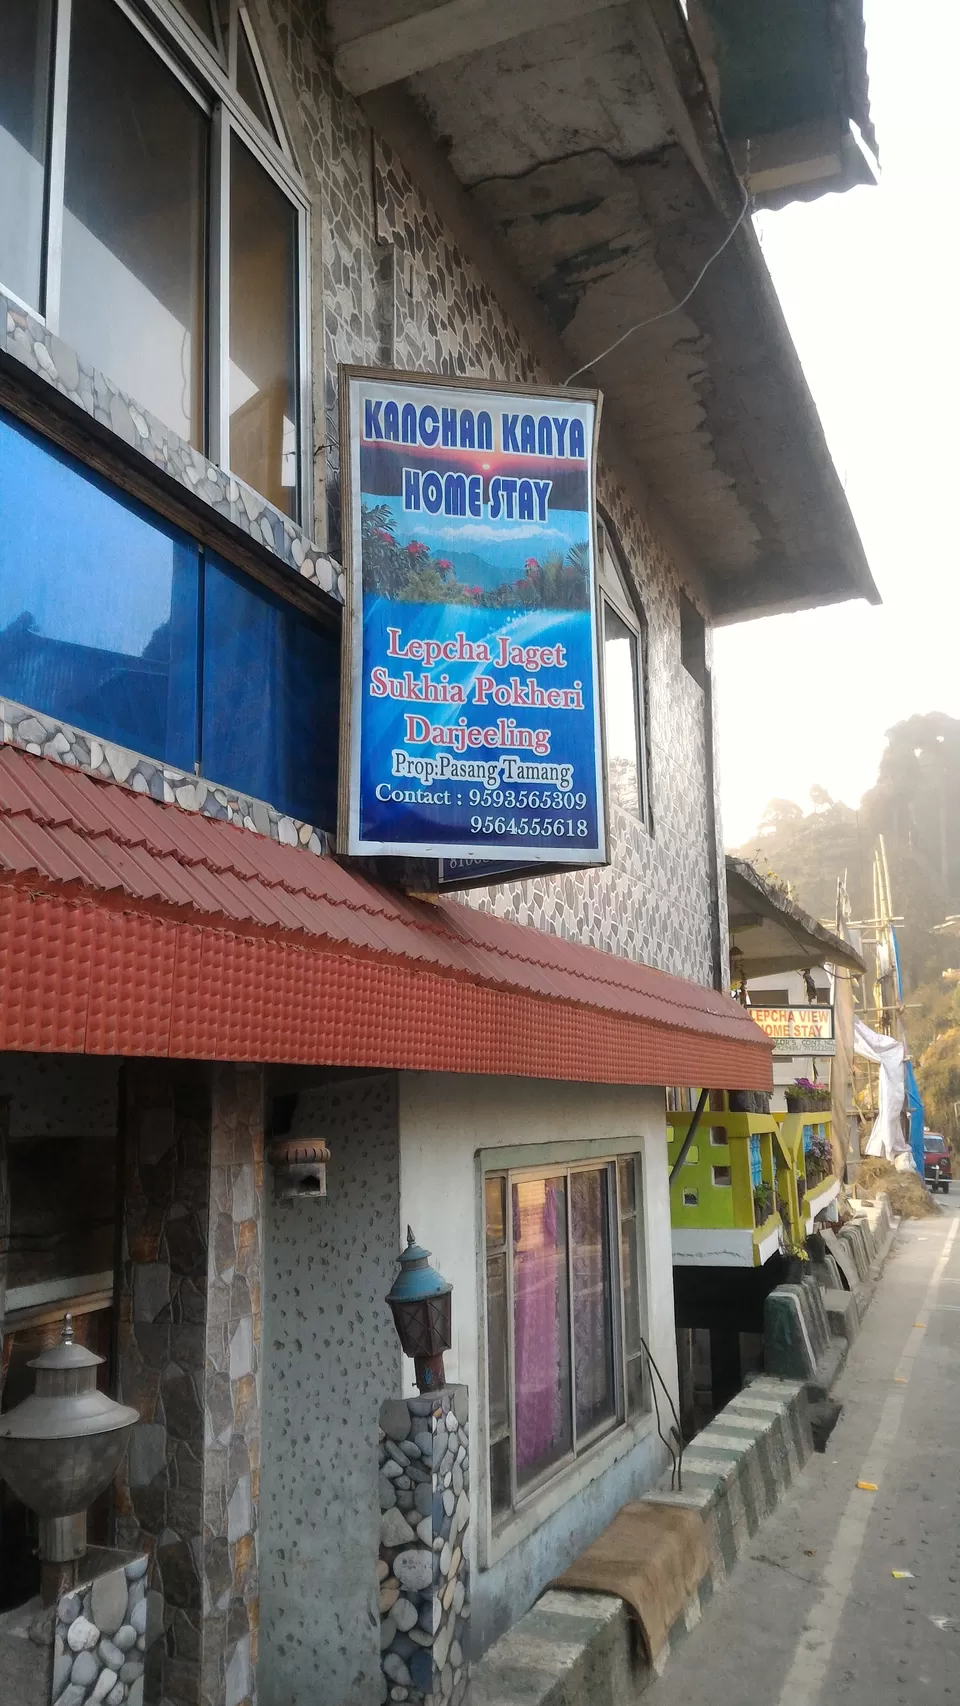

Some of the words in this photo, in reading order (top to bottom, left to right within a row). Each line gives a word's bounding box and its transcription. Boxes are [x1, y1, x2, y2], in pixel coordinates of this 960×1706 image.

[364, 398, 493, 451] KANCHAN
[501, 412, 586, 459] KANYA
[402, 468, 482, 518] HOME
[489, 477, 552, 521] STAY
[387, 629, 491, 665] Lepcha
[496, 637, 566, 671] Jaget
[371, 668, 466, 703] Sukhia
[474, 677, 583, 709] Pokheri
[405, 715, 550, 754] Darjeeling
[502, 758, 572, 789] Tamang
[375, 783, 451, 805] Contact
[469, 788, 587, 810] 9593565309
[470, 815, 588, 837] 9564555618
[793, 1025, 823, 1037] STAY
[799, 1010, 829, 1023] VIEW
